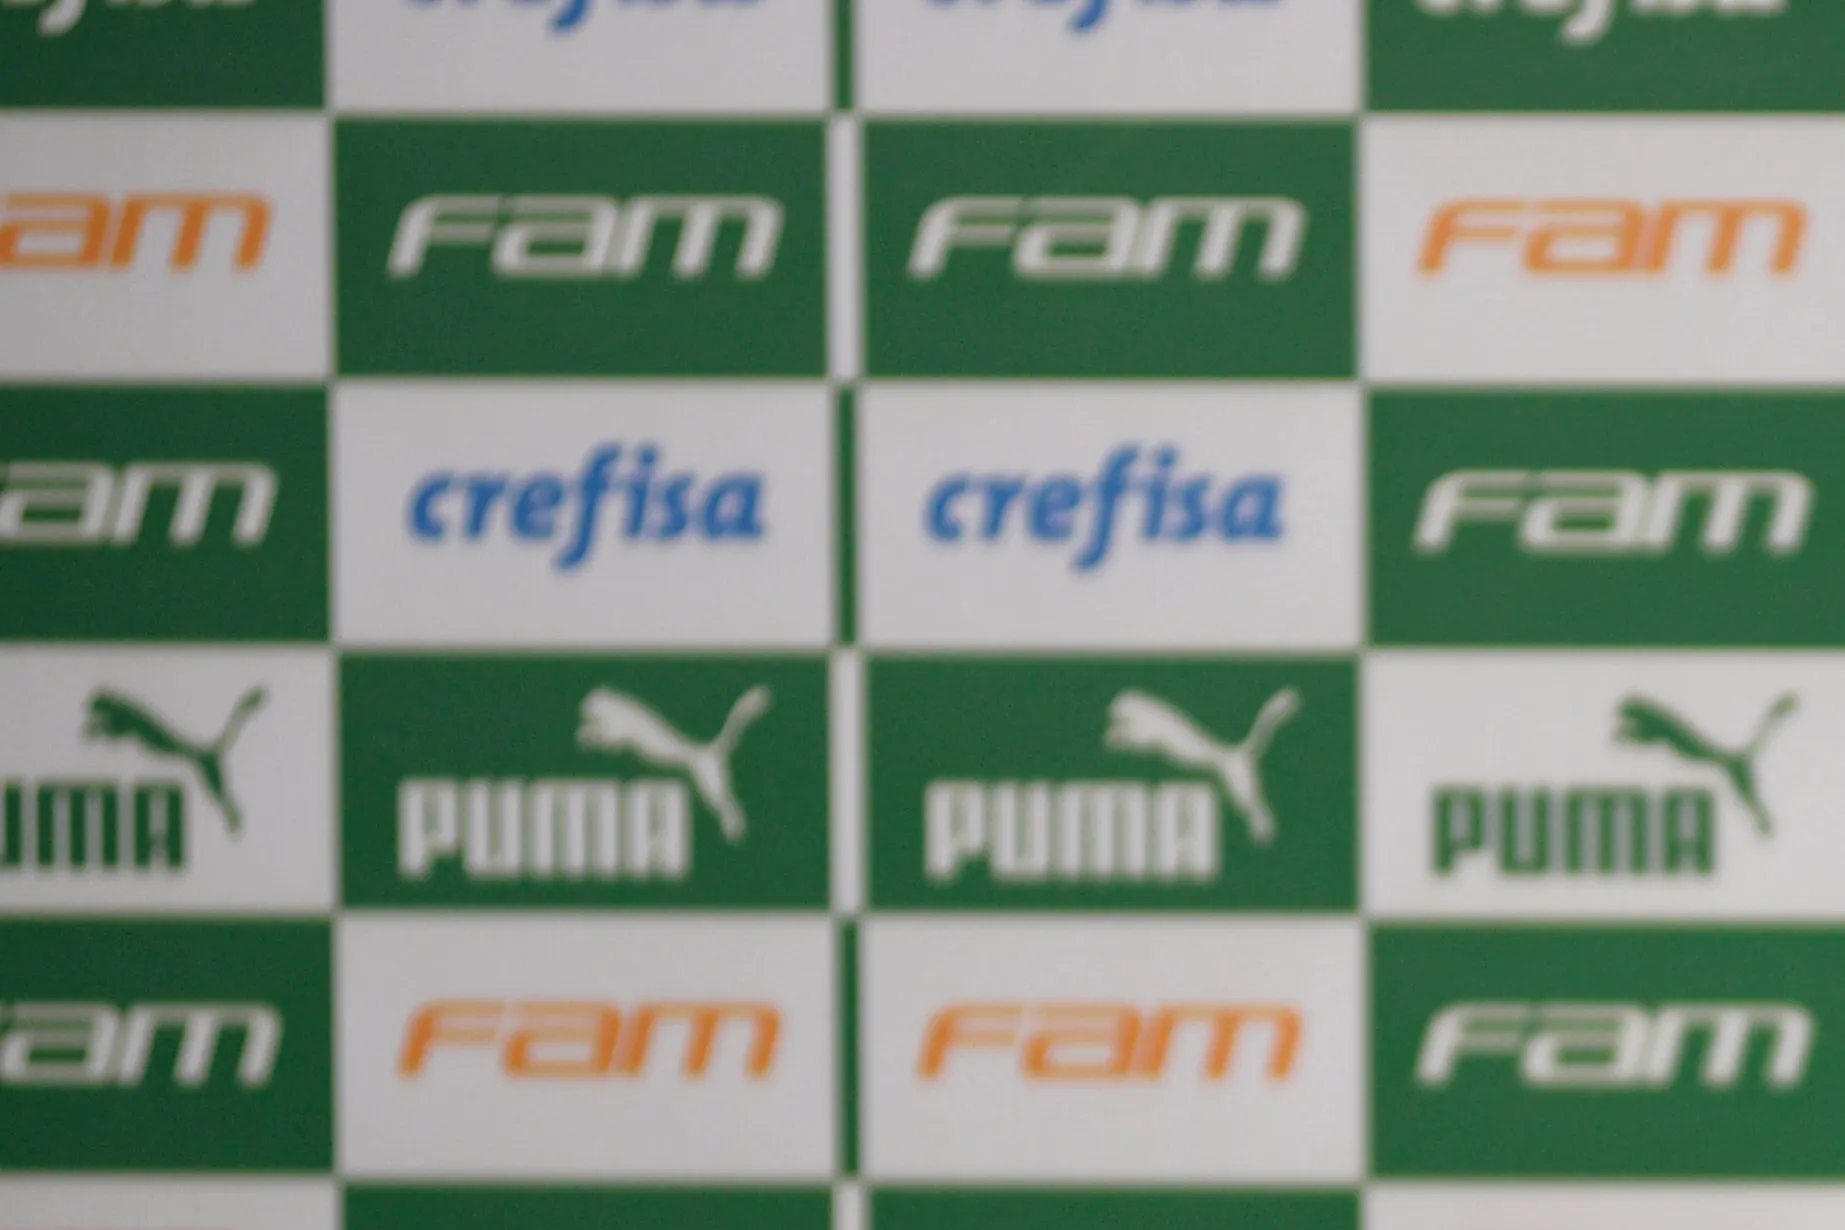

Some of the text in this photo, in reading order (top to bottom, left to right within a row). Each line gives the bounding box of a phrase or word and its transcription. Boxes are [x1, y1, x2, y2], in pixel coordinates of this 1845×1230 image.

[0, 193, 270, 270] am
[0, 463, 276, 544] am
[407, 443, 764, 571] crefisa
[924, 445, 1283, 573] crefisa
[400, 780, 690, 877] PUMA
[924, 781, 1220, 880] PUMA
[1431, 786, 1716, 877] PUMA
[0, 1005, 280, 1084] am
